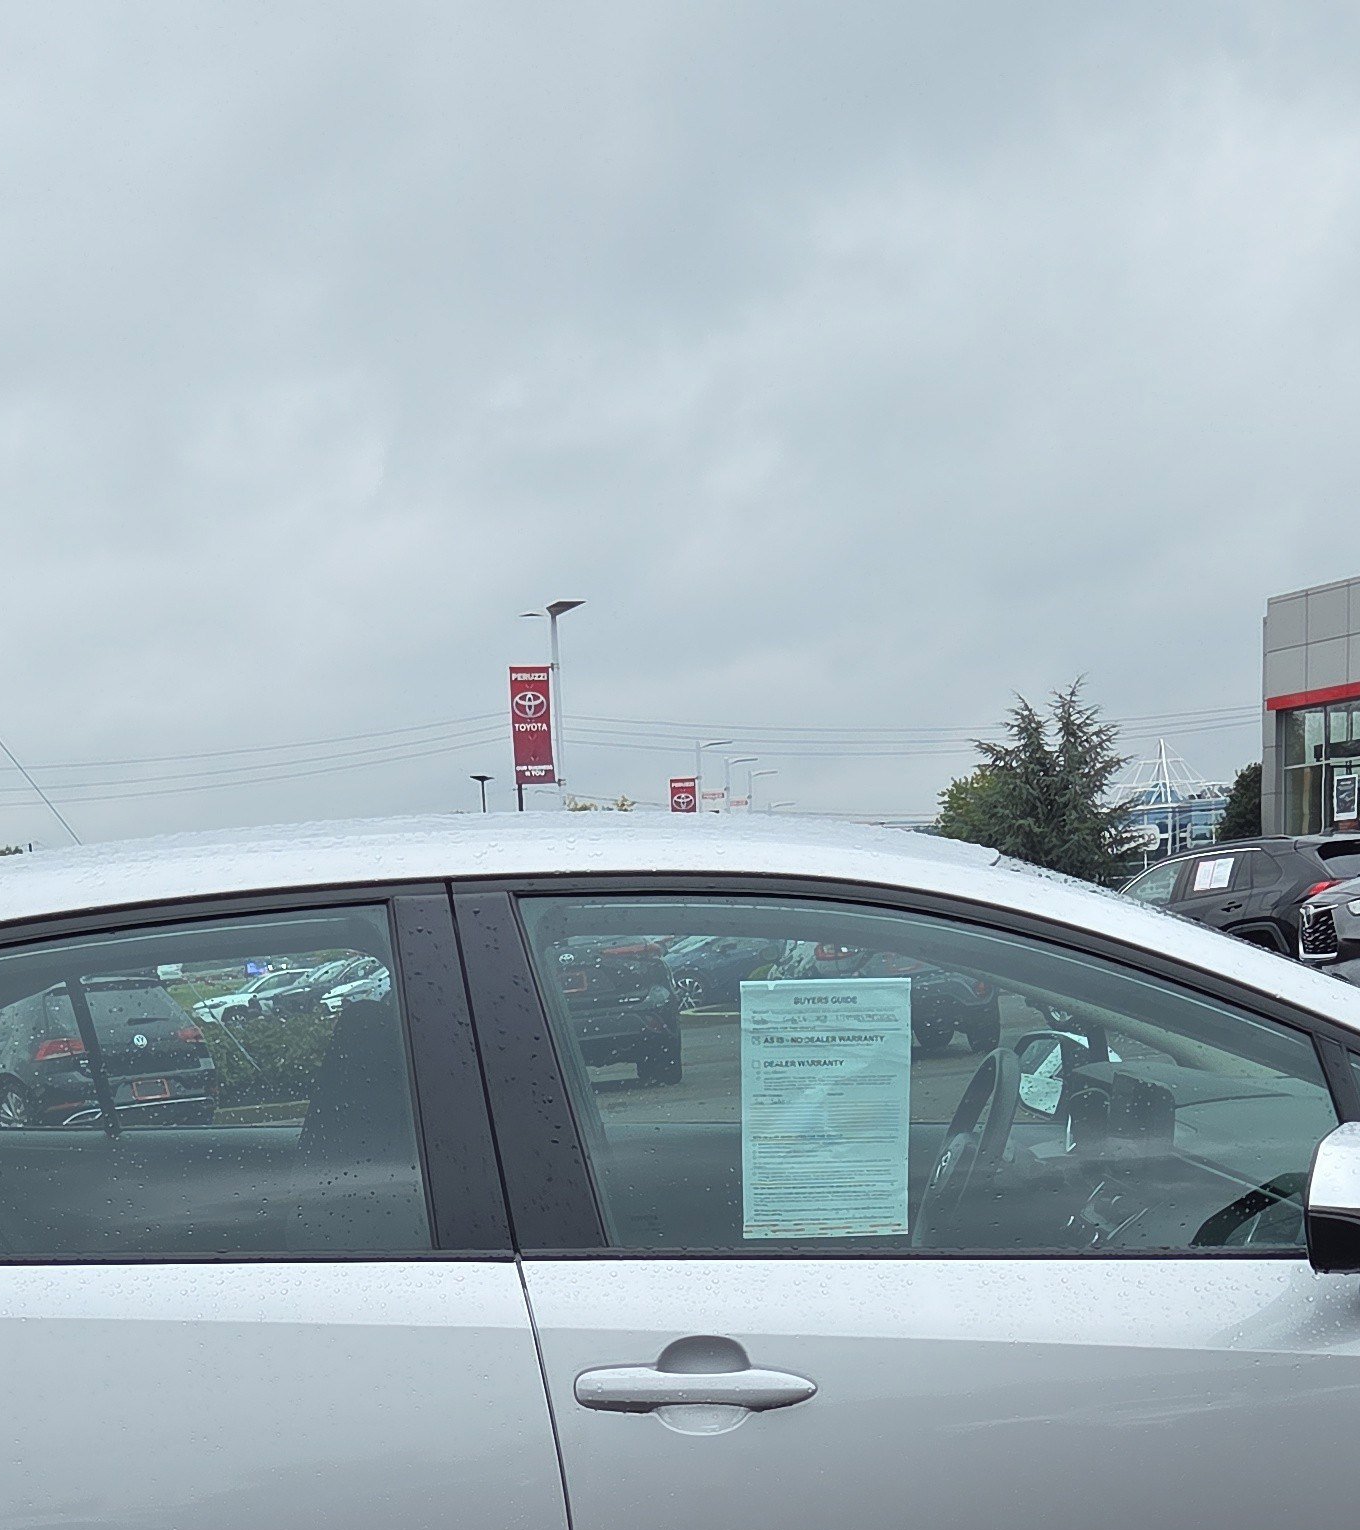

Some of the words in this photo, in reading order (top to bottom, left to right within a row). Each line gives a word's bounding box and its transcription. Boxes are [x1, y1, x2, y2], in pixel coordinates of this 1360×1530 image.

[514, 723, 548, 732] TOYOTA
[793, 996, 829, 1005] BUYERS
[830, 995, 858, 1005] GUIDE
[763, 1036, 775, 1044] AS
[791, 1036, 803, 1044] NO
[803, 1035, 838, 1044] DEALER
[839, 1035, 886, 1044] WARRANTY
[763, 1059, 796, 1068] DEALER
[797, 1059, 845, 1068] WARRANTY
